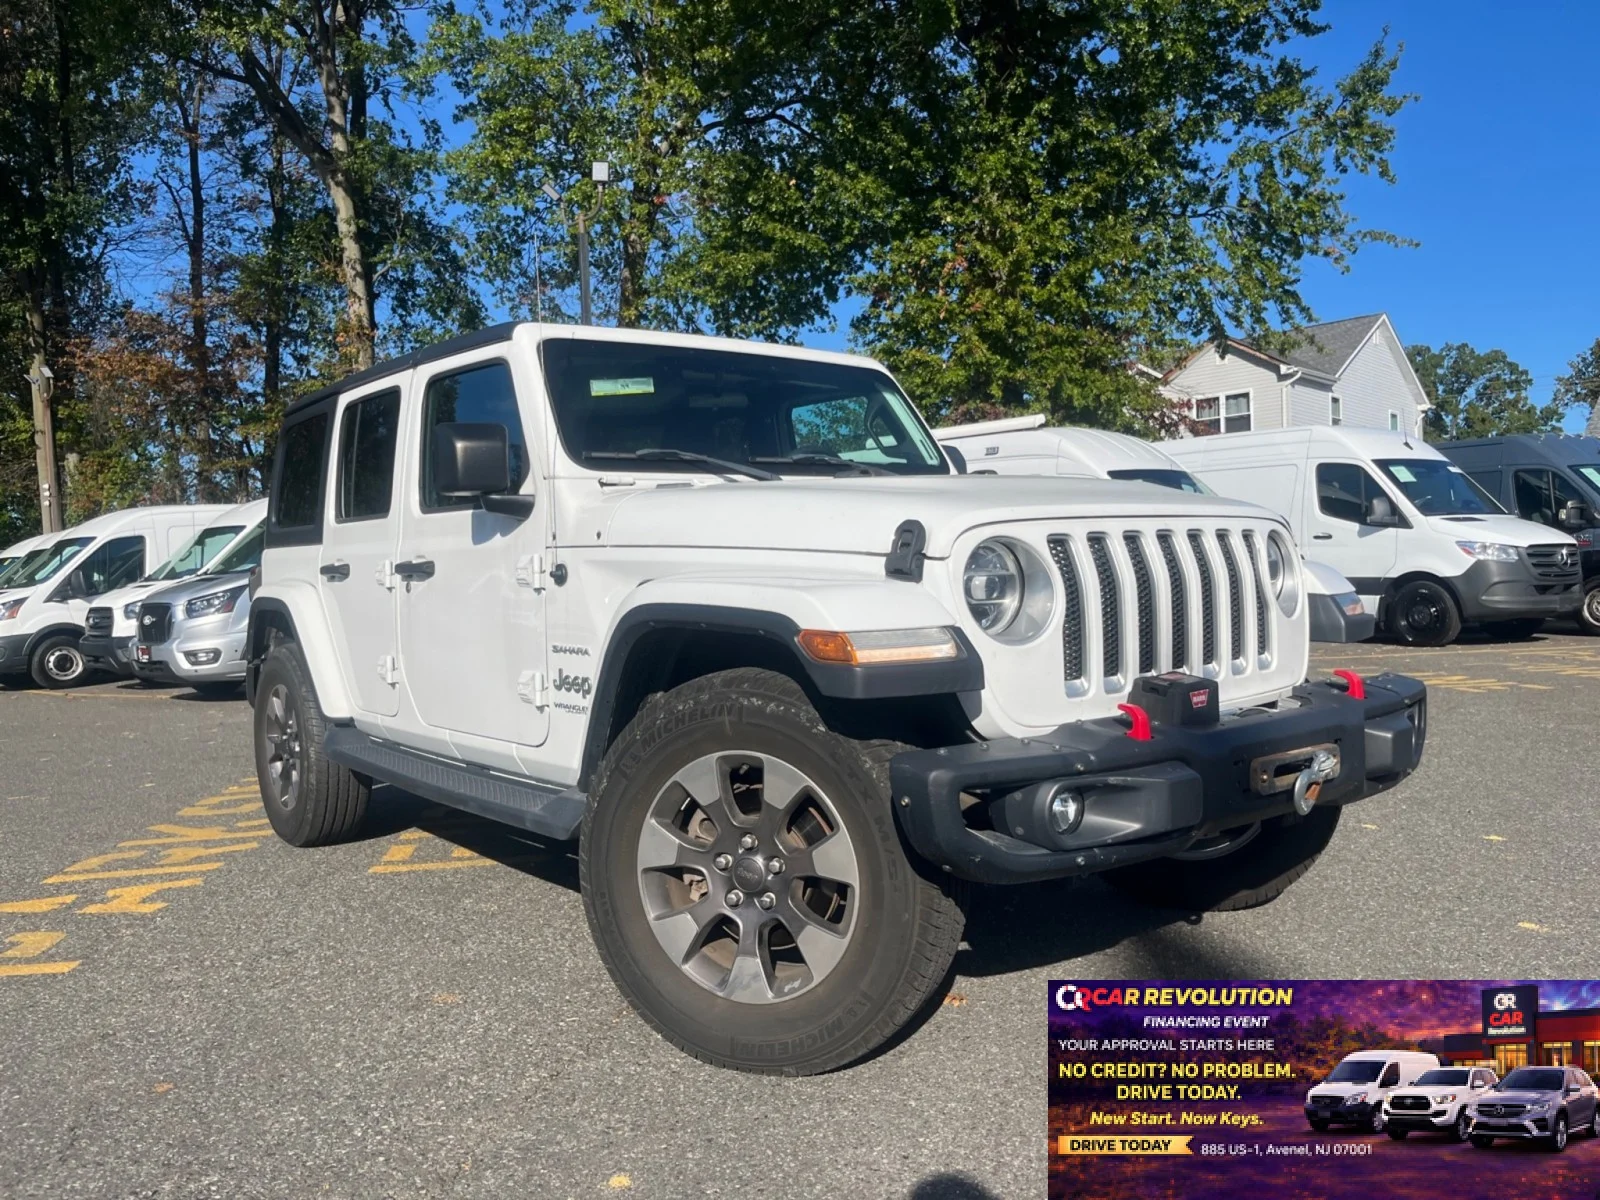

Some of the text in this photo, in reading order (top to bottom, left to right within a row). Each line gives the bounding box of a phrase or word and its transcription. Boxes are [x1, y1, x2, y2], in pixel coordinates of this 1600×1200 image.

[552, 645, 591, 657] SAHARA
[553, 668, 592, 699] Jeep
[641, 702, 739, 756] MICHELIN
